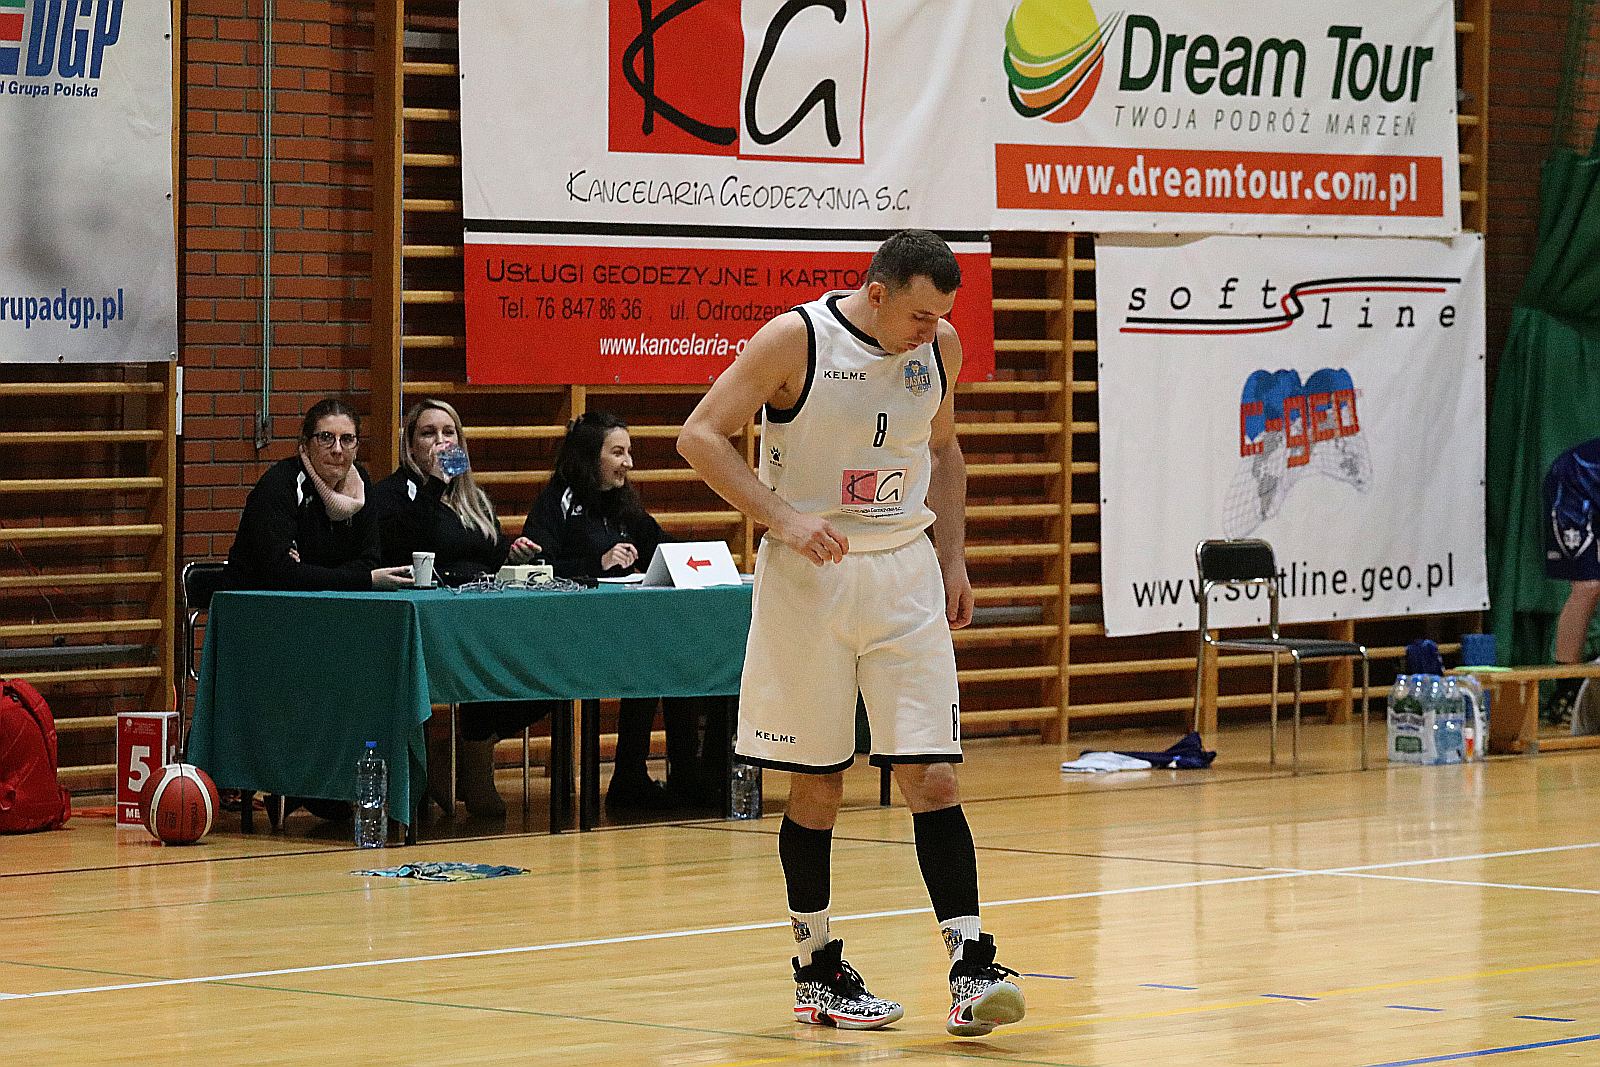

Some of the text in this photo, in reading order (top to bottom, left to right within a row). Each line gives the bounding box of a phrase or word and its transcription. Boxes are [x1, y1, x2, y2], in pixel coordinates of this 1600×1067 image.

[26, 0, 124, 79] DGP
[1119, 14, 1434, 103] Dream Tour
[8, 81, 50, 98] Grupa
[53, 83, 99, 97] Polska
[1114, 105, 1417, 137] TWOJA PODRÓŻ MARZEŃ
[720, 175, 870, 211] GEODEZYJNA
[877, 186, 911, 212] S.C.
[1025, 154, 1418, 211] www.dreamtour.com.pl
[486, 259, 584, 284] USŁUGI
[593, 265, 759, 288] GEODEZYJNE
[767, 268, 771, 287] I
[0, 288, 124, 329] rupadgp.pl
[497, 295, 529, 319] Tel.
[536, 297, 555, 320] 76
[561, 298, 595, 320] 847
[599, 298, 616, 320] 86
[620, 298, 642, 320] 36
[669, 300, 689, 320] ul.
[823, 370, 868, 381] KELME
[872, 412, 888, 448] 8
[755, 729, 797, 744] KELME
[127, 745, 151, 793] 5
